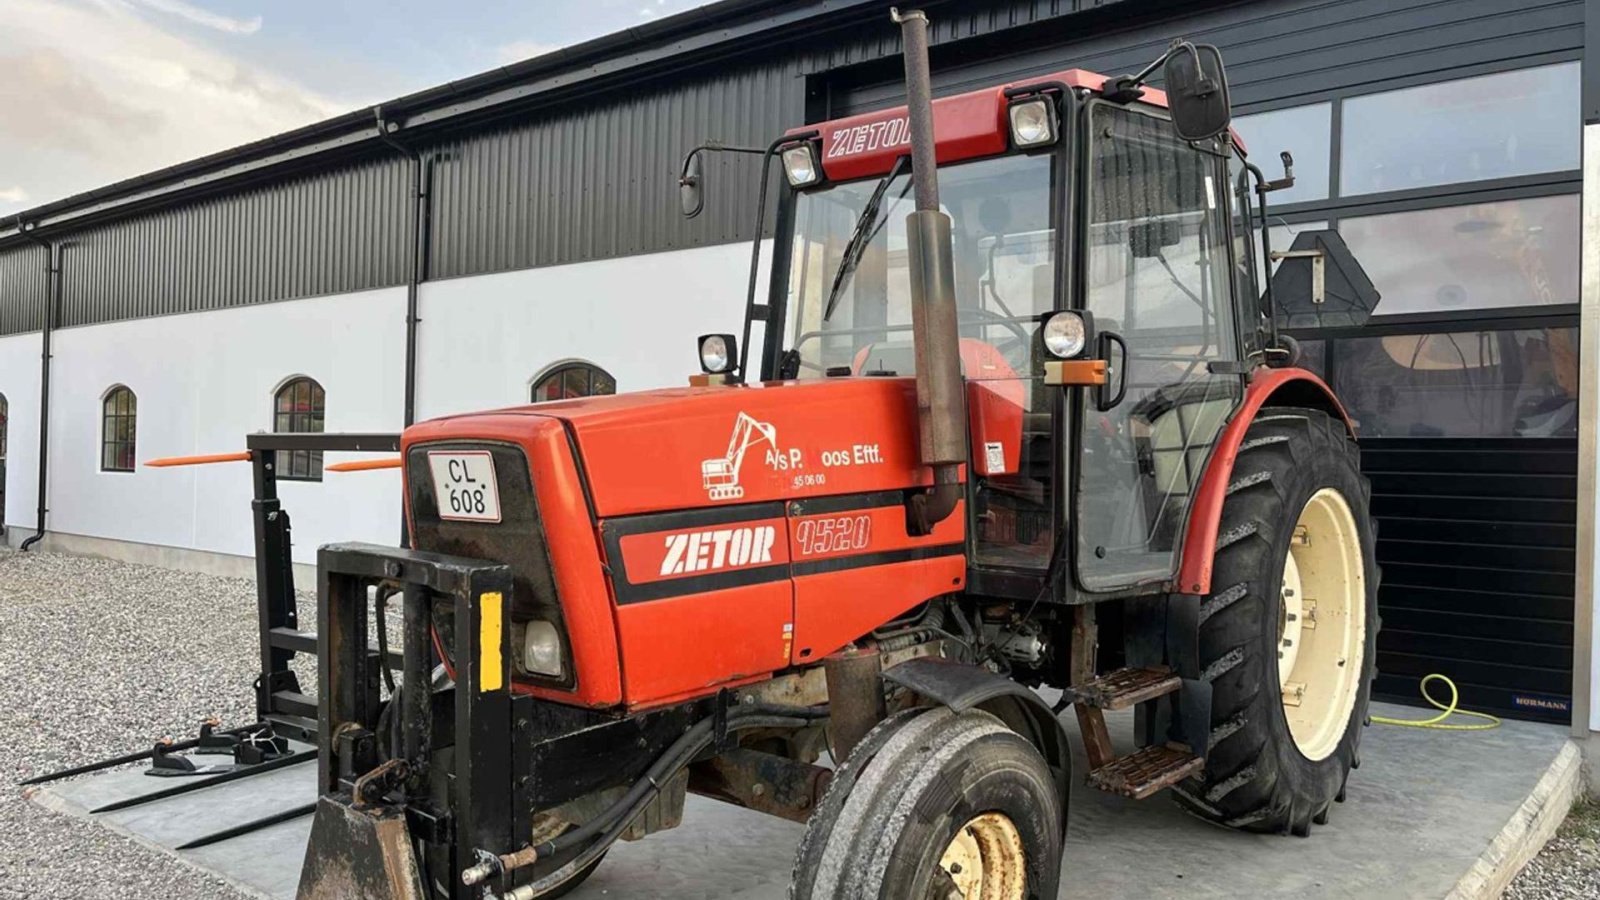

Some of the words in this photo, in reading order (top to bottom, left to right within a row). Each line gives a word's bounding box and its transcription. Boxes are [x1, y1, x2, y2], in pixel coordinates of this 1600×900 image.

[449, 459, 476, 483] CL
[815, 473, 826, 485] 00
[450, 489, 485, 513] 608
[660, 526, 775, 576] ZETOR
[797, 515, 871, 555] 9520
